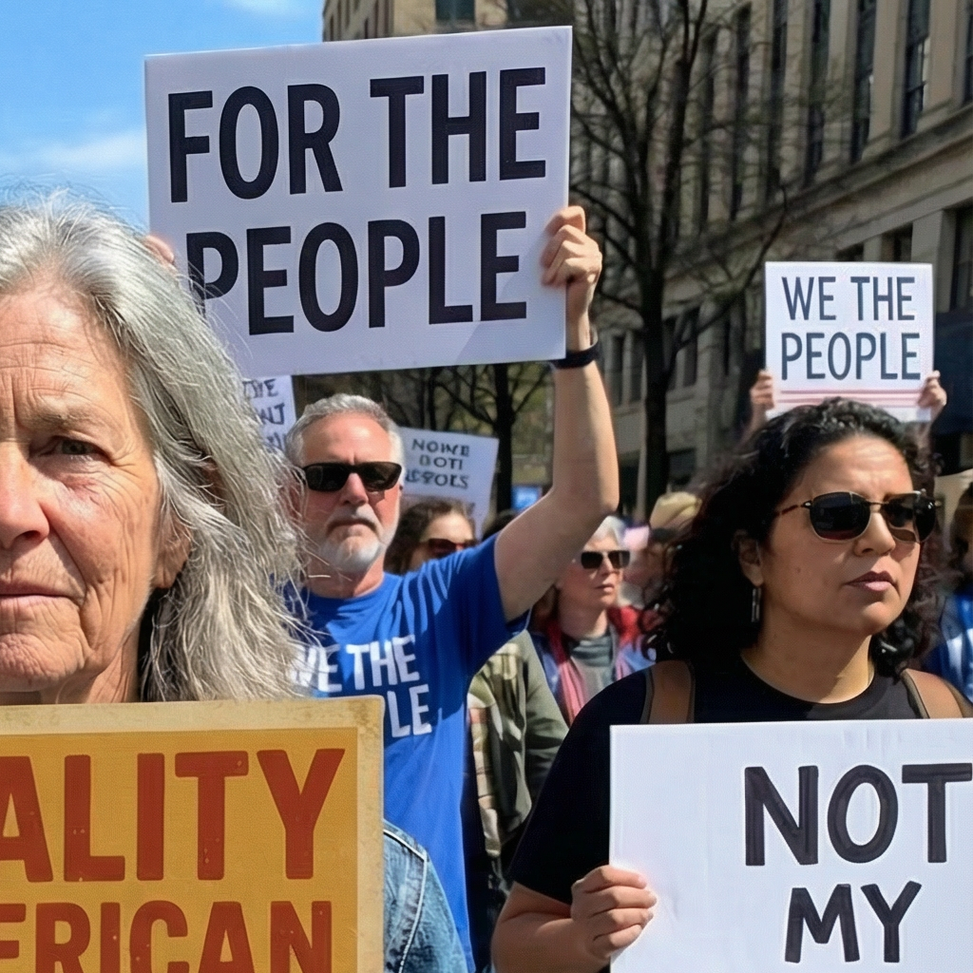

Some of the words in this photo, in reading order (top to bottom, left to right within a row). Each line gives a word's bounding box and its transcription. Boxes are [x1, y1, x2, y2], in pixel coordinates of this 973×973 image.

[168, 83, 343, 203] FOR
[370, 66, 546, 188] THE
[186, 211, 527, 336] PEOPLE
[781, 276, 837, 320] WE
[850, 276, 915, 321] THE
[781, 332, 921, 380] PEOPLE
[346, 634, 420, 690] THE
[744, 763, 972, 866] NOT
[784, 880, 922, 963] MY
